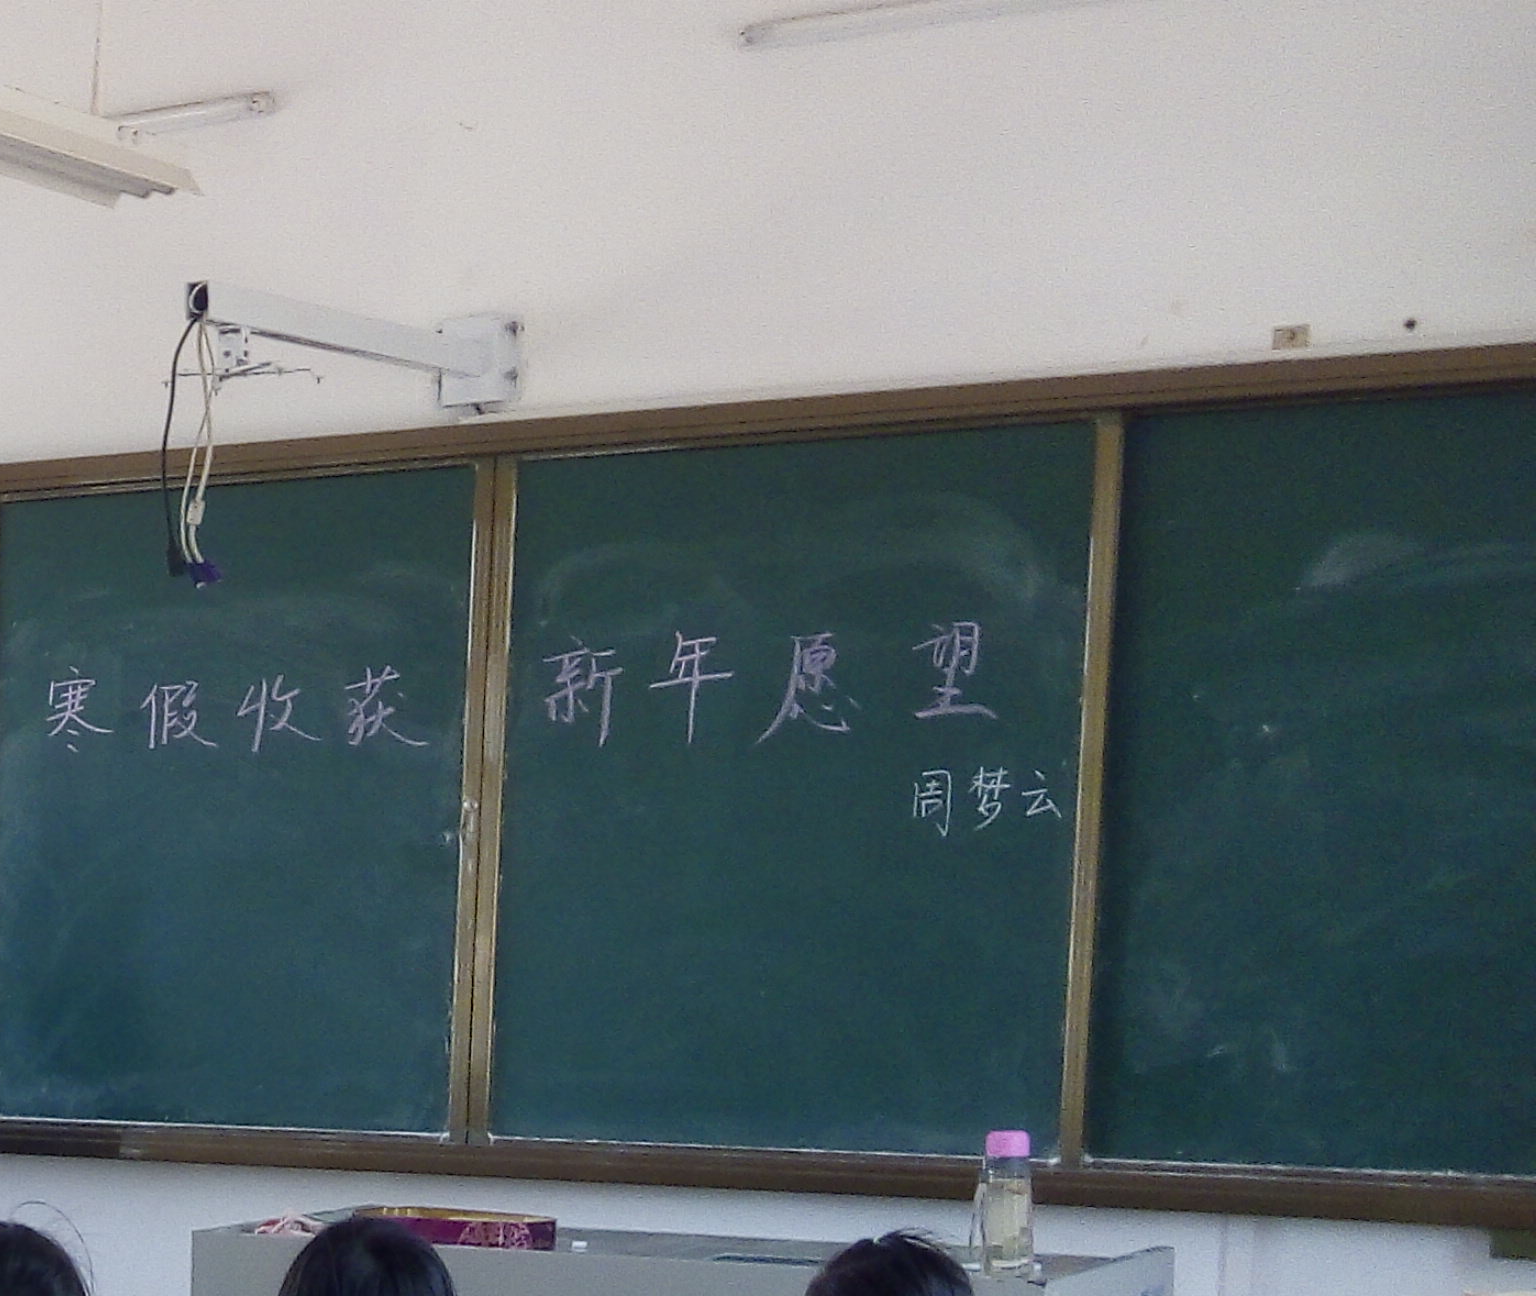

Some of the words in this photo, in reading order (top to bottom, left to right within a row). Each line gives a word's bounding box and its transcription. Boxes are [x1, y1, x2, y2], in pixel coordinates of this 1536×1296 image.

[46, 664, 430, 754] 寒假收获
[540, 620, 998, 748] 新年愿望
[912, 765, 1063, 838] 周梦云
